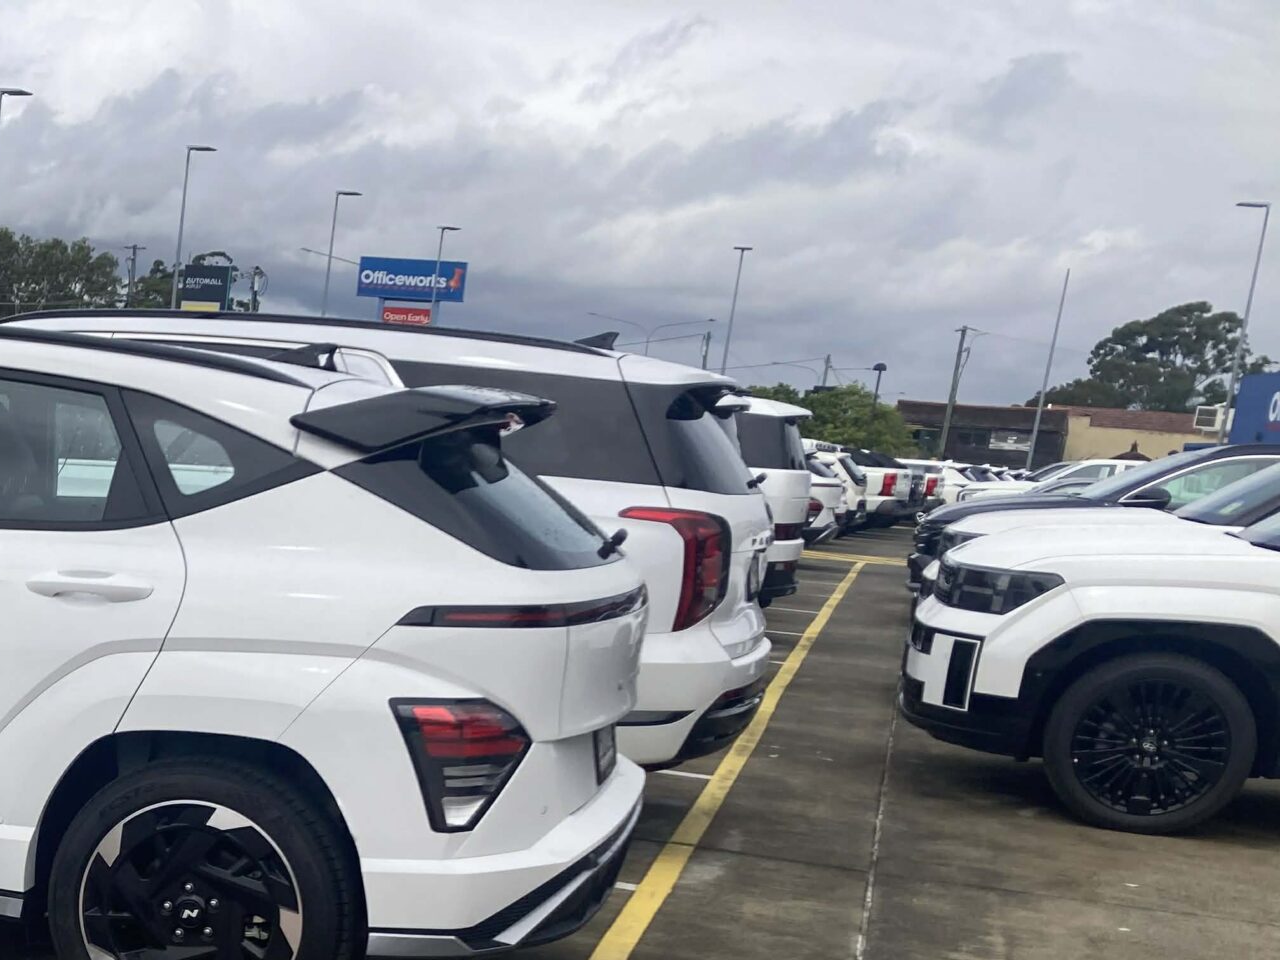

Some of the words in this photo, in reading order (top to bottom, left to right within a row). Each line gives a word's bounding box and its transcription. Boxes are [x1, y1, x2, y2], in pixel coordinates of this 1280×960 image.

[185, 277, 223, 286] AUTOMALL
[360, 269, 448, 288] Officeworks
[383, 311, 407, 322] Open
[407, 313, 431, 324] Early
